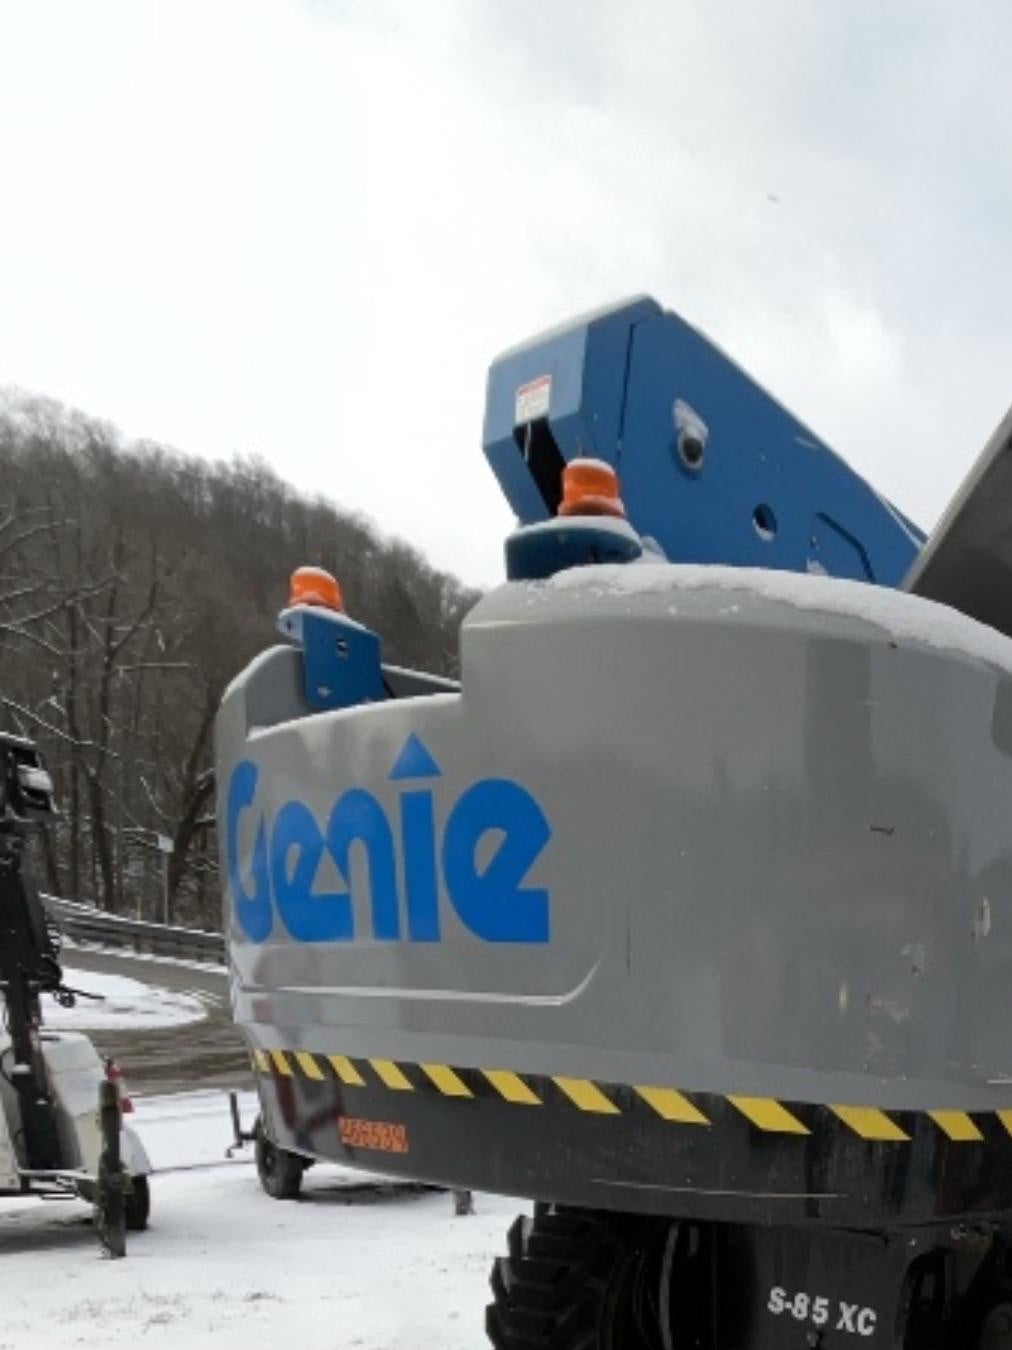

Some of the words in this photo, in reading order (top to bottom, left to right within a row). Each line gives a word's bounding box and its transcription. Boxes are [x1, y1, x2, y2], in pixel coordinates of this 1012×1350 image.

[227, 732, 552, 944] Genie
[767, 1286, 829, 1325] S-85
[836, 1301, 877, 1337] XC
